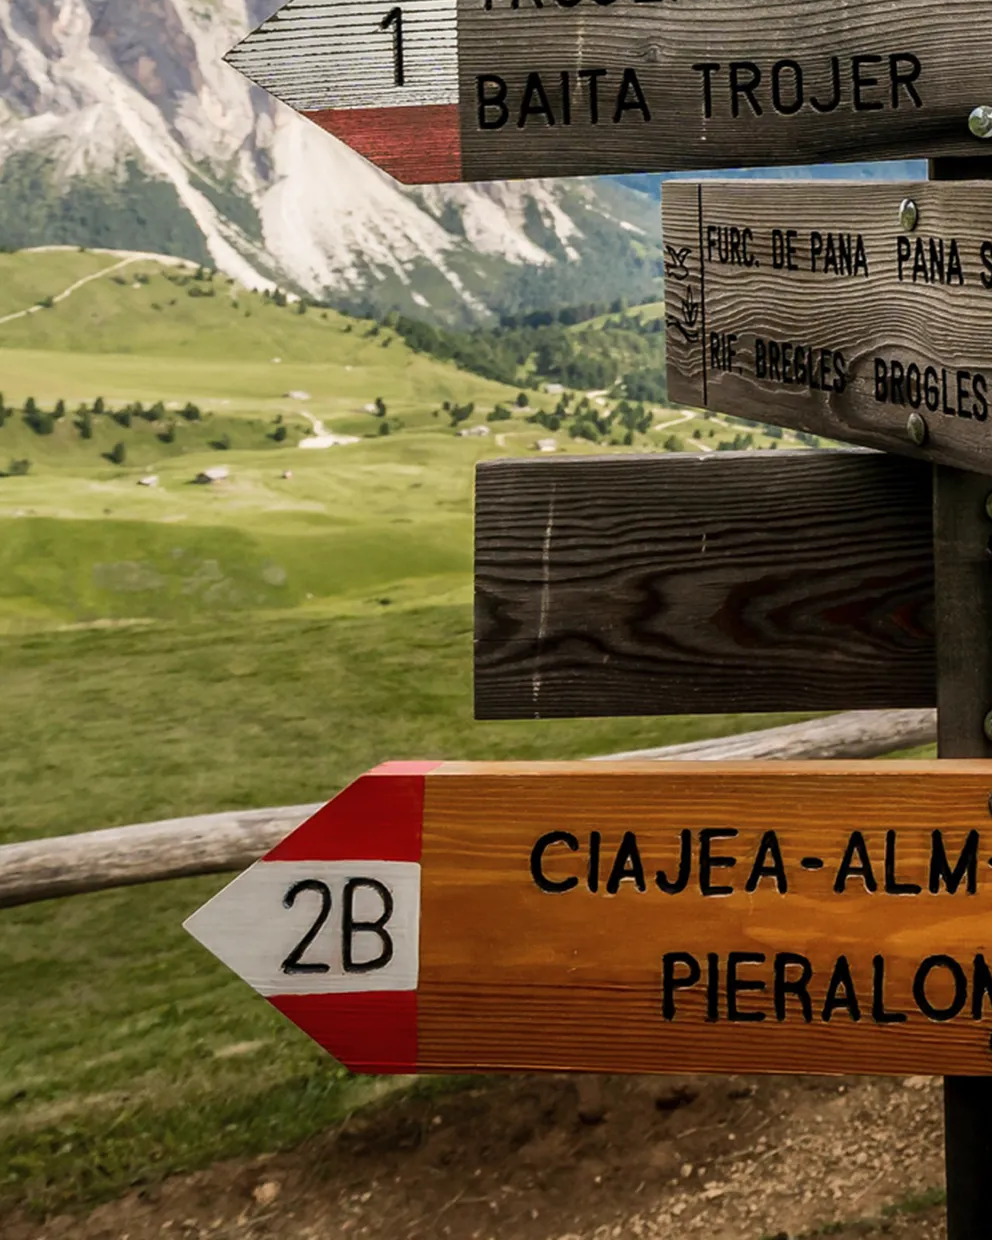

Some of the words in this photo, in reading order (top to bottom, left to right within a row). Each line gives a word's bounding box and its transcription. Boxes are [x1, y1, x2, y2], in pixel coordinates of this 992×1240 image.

[375, 6, 404, 87] 1
[475, 67, 652, 131] BAITA
[692, 52, 923, 120] TROJER
[706, 225, 760, 269] FURC.
[771, 228, 799, 271] DE
[810, 231, 869, 278] PANA
[897, 235, 964, 287] PANA
[873, 357, 989, 422] BROGLES
[280, 876, 394, 974] 2B
